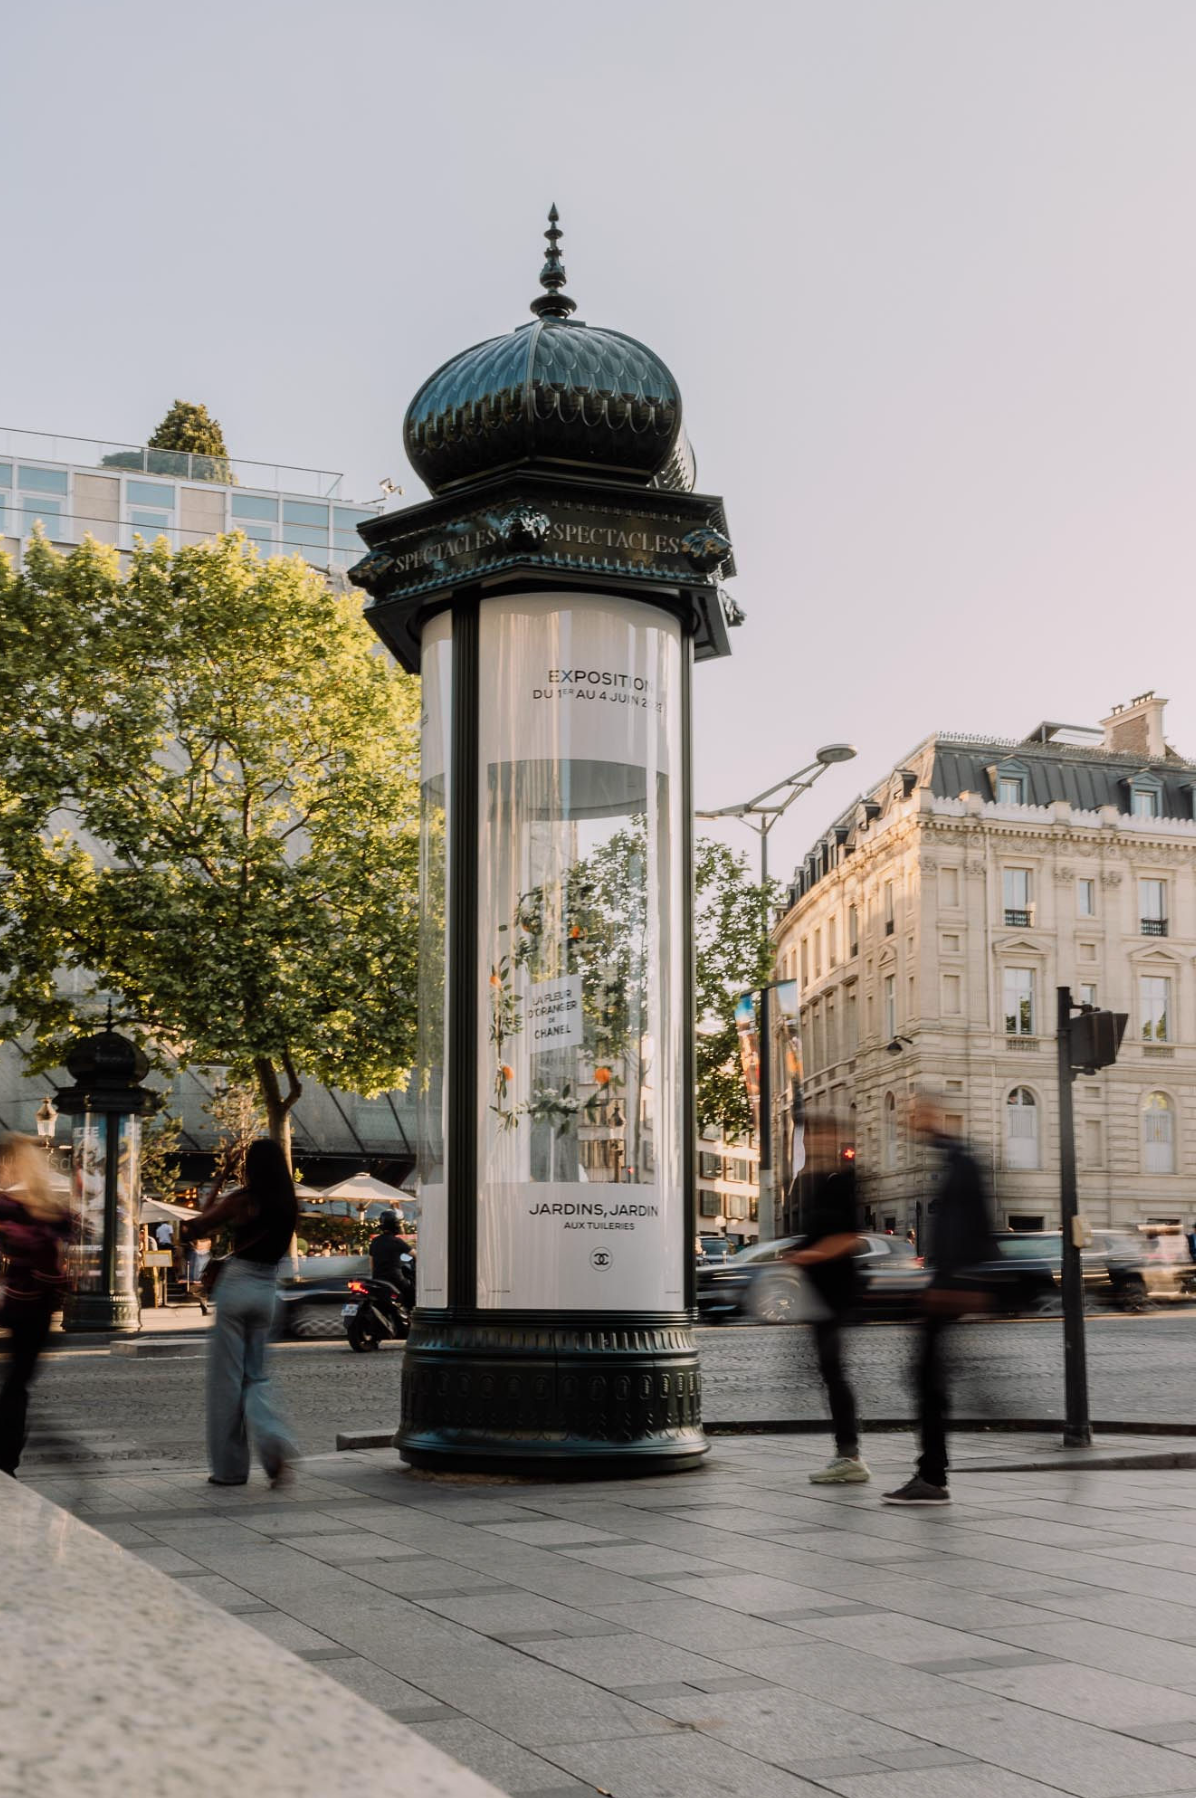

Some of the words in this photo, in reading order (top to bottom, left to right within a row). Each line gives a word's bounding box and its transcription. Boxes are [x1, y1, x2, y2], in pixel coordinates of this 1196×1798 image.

[553, 523, 680, 554] SPECTACLES
[395, 527, 498, 573] SPECTACLES
[533, 689, 553, 699] DU
[576, 690, 596, 700] AU
[599, 691, 607, 700] 4
[610, 692, 639, 706] JUIN
[534, 1024, 571, 1039] CHANEL
[529, 1203, 608, 1218] JARDINS,
[609, 1204, 659, 1217] JARDIN
[563, 1222, 585, 1230] AUX
[587, 1222, 635, 1230] TUILERIES
